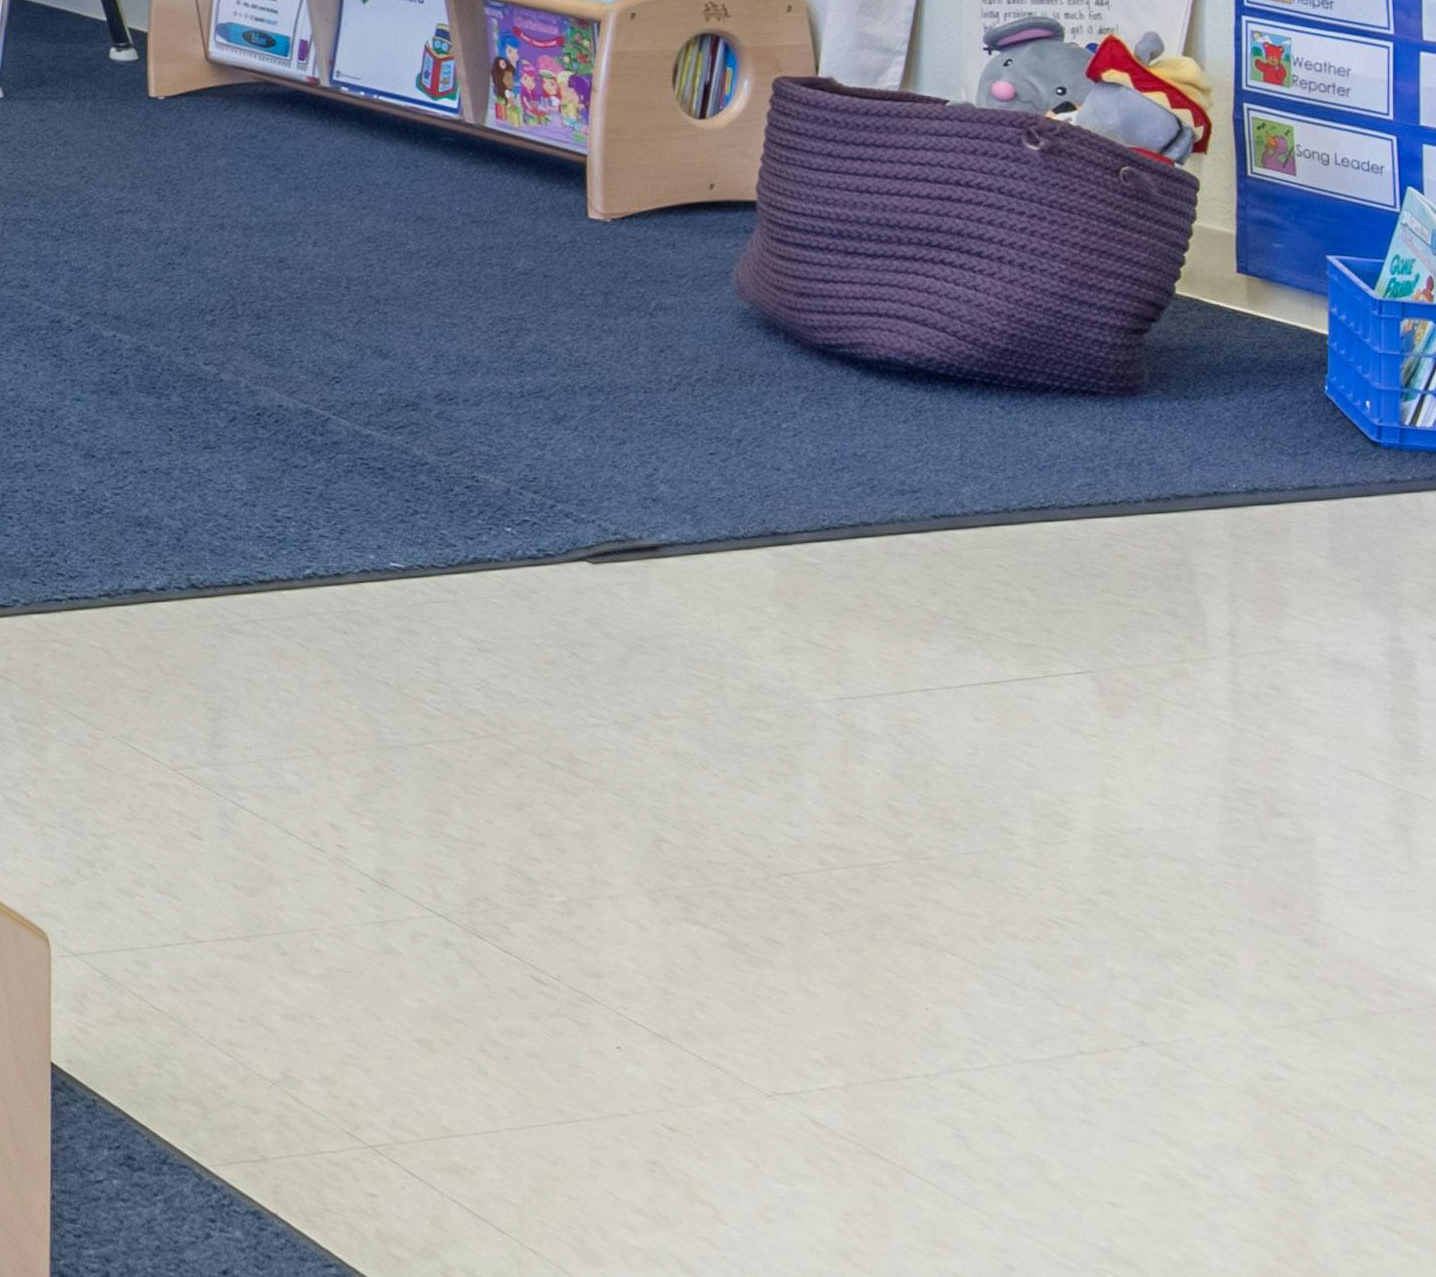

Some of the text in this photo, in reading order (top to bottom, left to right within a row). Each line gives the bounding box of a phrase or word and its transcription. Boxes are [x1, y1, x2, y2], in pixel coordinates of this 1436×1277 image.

[1292, 55, 1352, 78] Weather
[1291, 74, 1352, 97] Reporter
[1296, 144, 1385, 176] Song Leader
